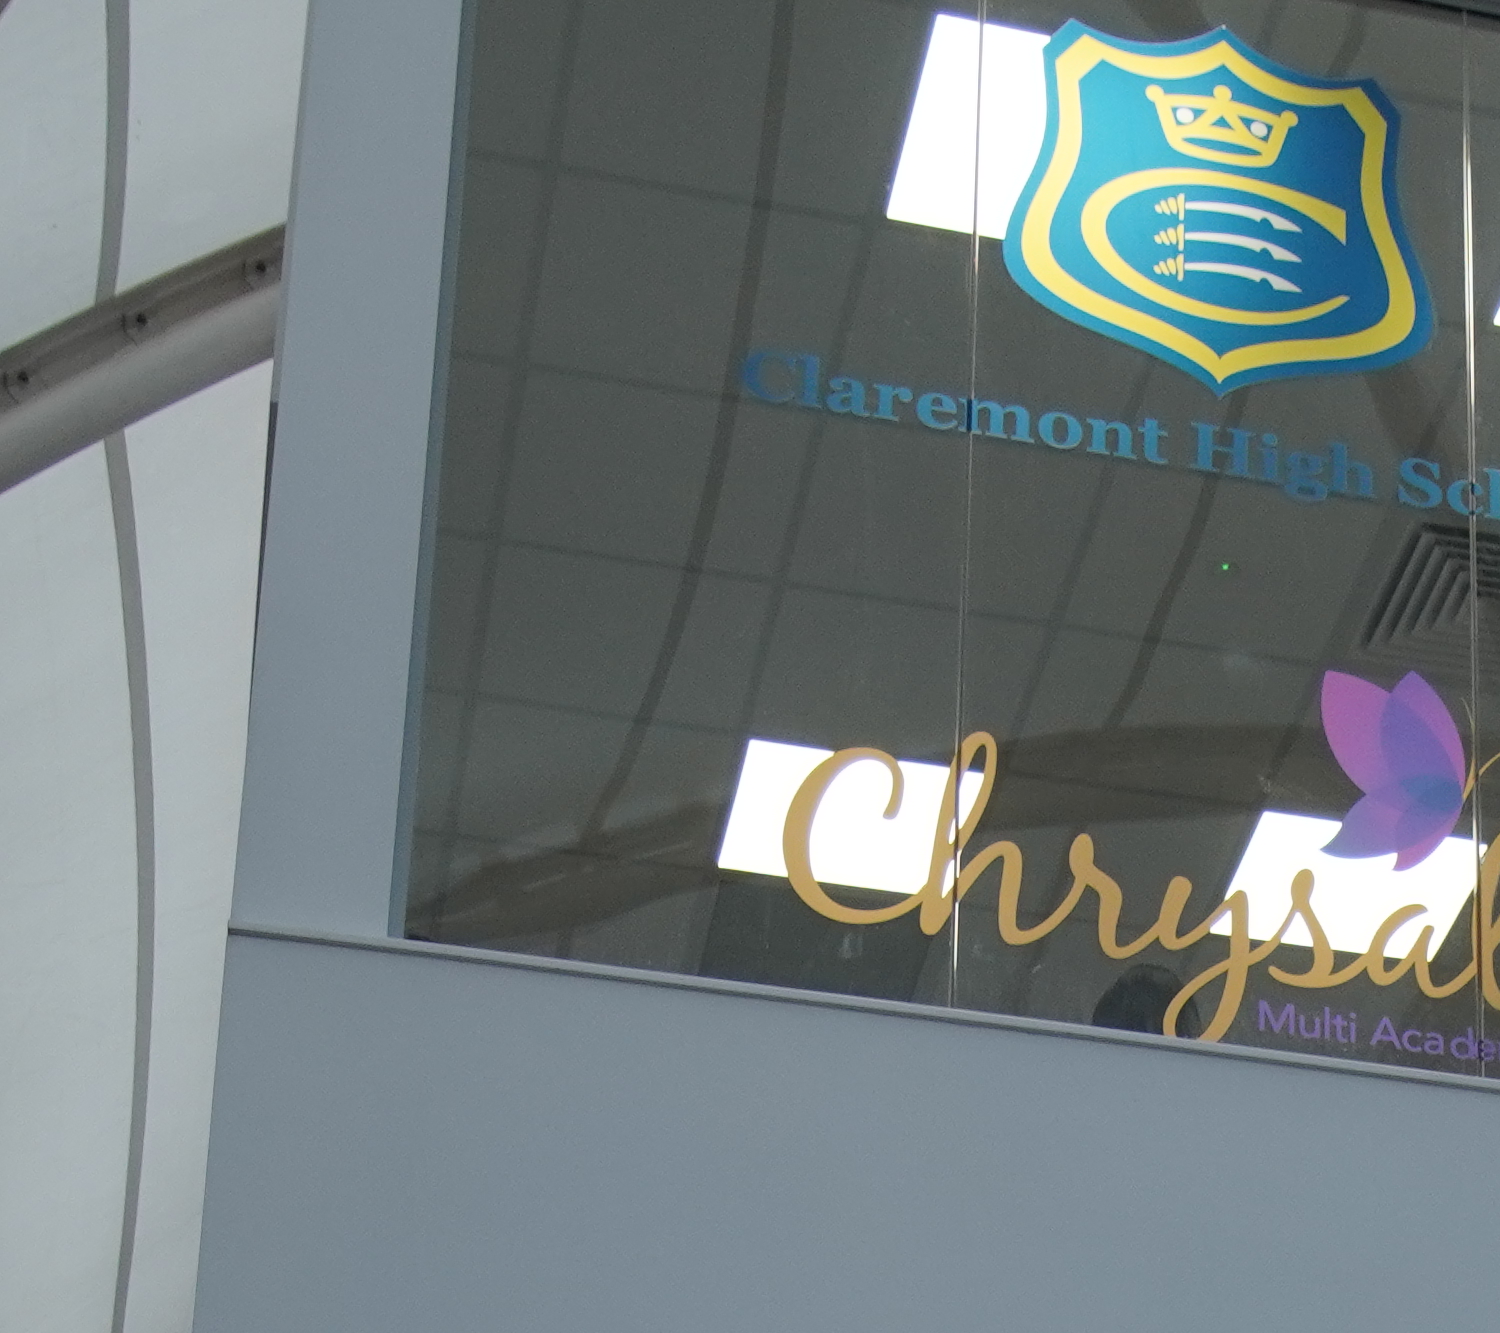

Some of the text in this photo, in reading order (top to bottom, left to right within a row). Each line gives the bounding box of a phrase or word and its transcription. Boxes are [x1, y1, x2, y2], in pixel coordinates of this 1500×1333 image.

[741, 349, 1170, 466] Claremont
[1192, 420, 1374, 502] High
[1257, 1000, 1357, 1044] Multi
